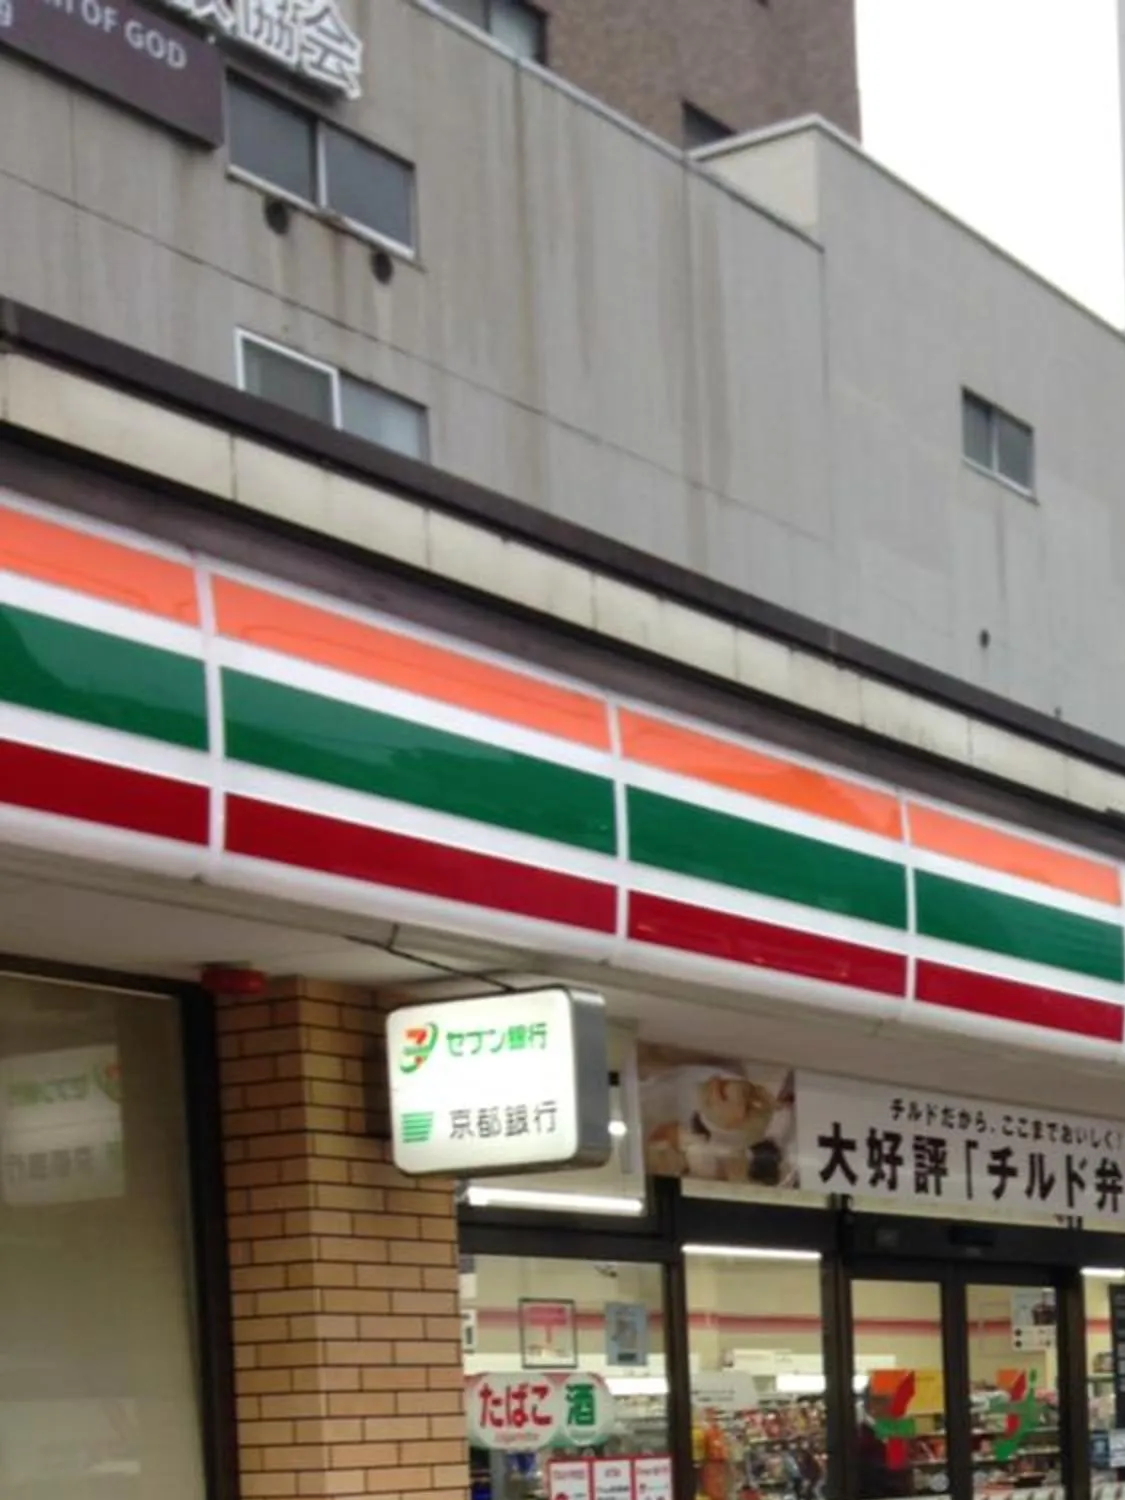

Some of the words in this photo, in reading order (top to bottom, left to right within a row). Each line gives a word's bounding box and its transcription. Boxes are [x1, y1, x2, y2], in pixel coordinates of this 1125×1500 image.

[124, 20, 187, 69] GOD
[446, 1022, 548, 1057] セブン銀行
[449, 1100, 558, 1139] 京都銀行
[478, 1382, 553, 1429] たばこ
[565, 1383, 596, 1427] 酒
